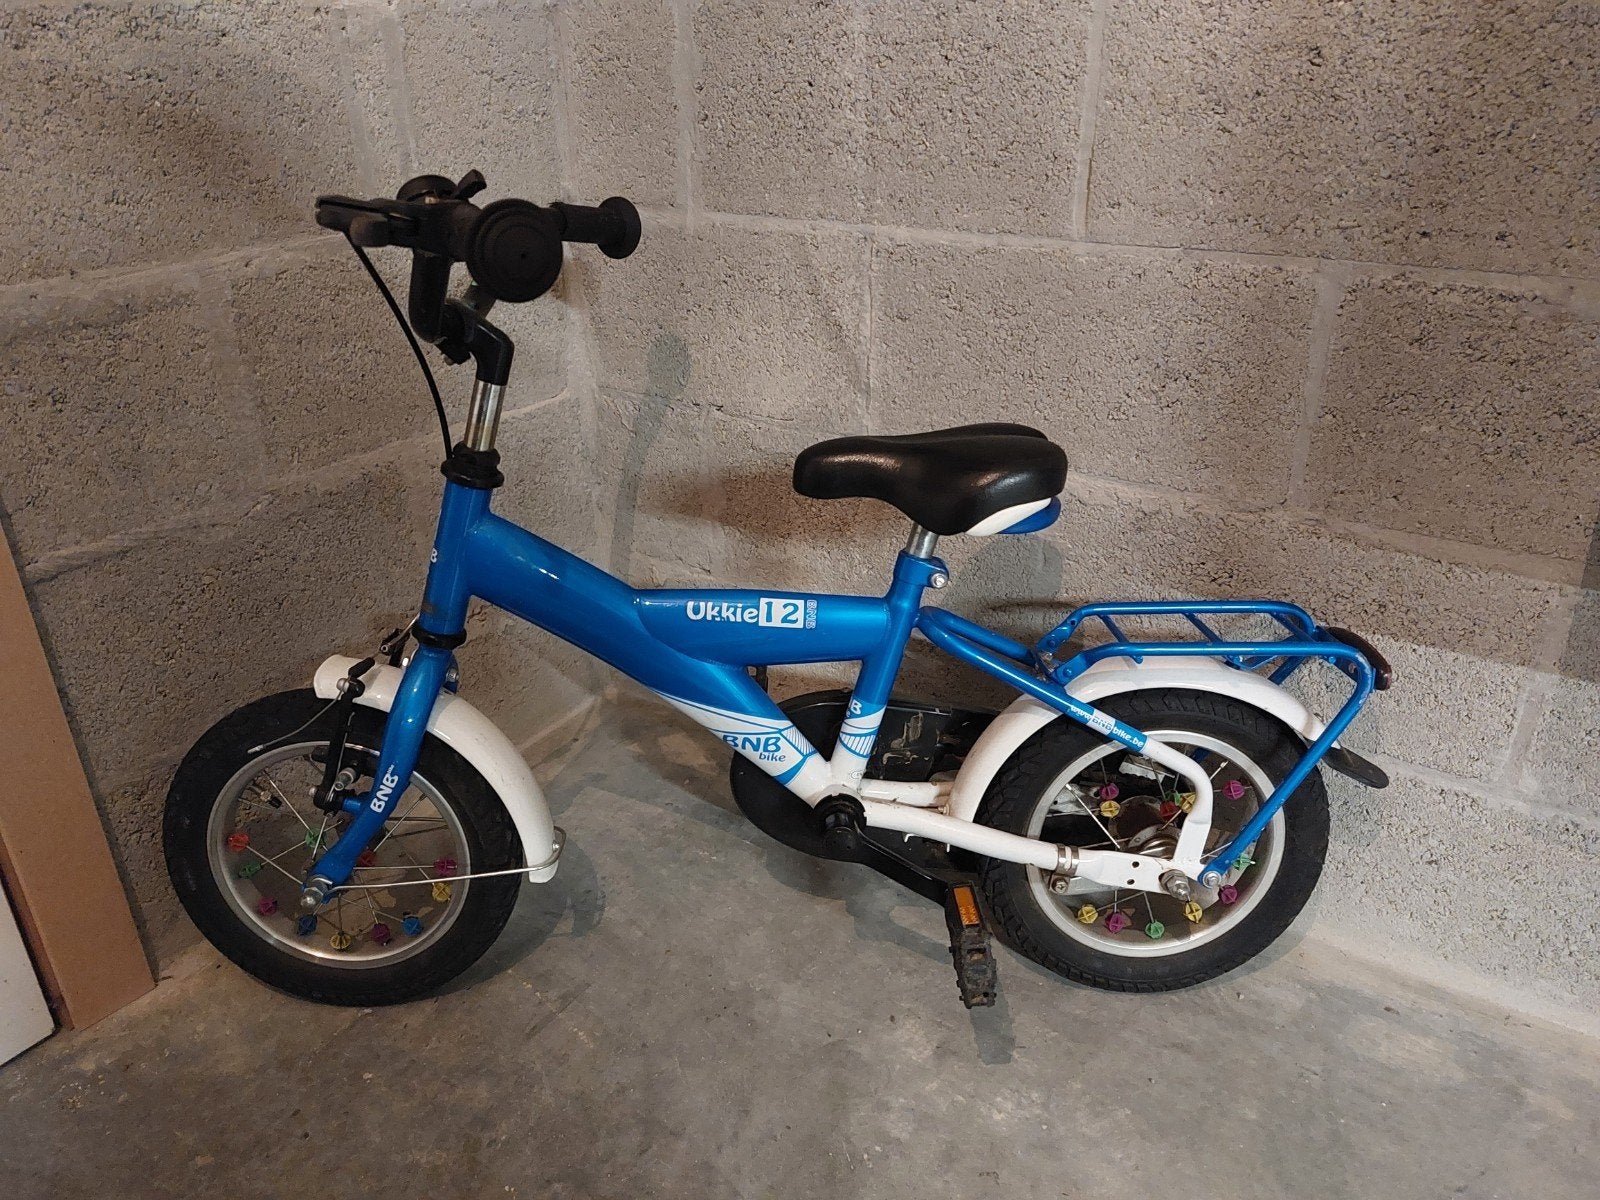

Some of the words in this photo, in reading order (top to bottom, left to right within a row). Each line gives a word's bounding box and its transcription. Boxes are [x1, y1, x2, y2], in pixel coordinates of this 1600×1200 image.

[686, 600, 759, 623] Ukkie
[764, 600, 799, 625] 12
[722, 734, 782, 753] BNB
[758, 752, 786, 763] bike
[370, 772, 399, 813] BNB
